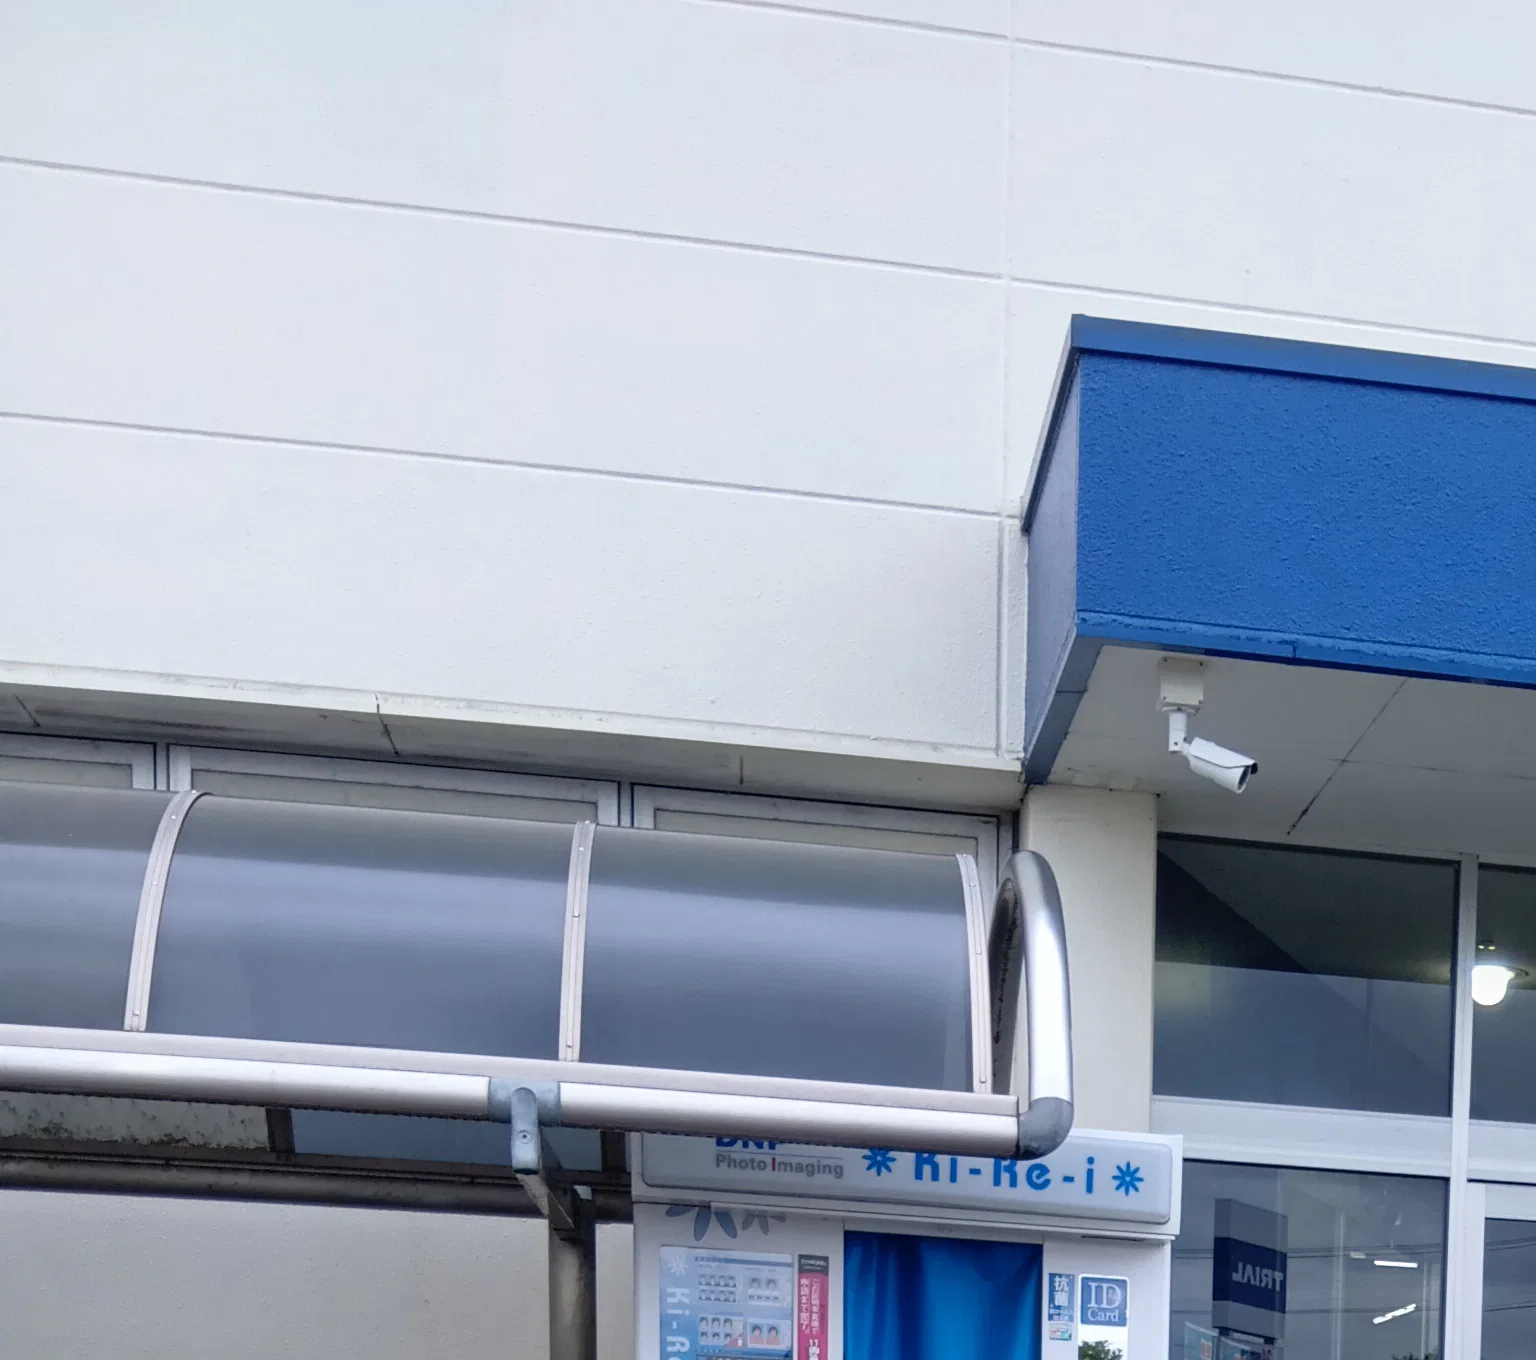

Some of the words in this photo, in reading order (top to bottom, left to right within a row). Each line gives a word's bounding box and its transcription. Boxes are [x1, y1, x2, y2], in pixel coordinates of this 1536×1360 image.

[715, 1154, 767, 1173] Photo
[770, 1157, 844, 1179] Imaging
[1086, 1281, 1122, 1308] ID
[1087, 1307, 1120, 1322] Card
